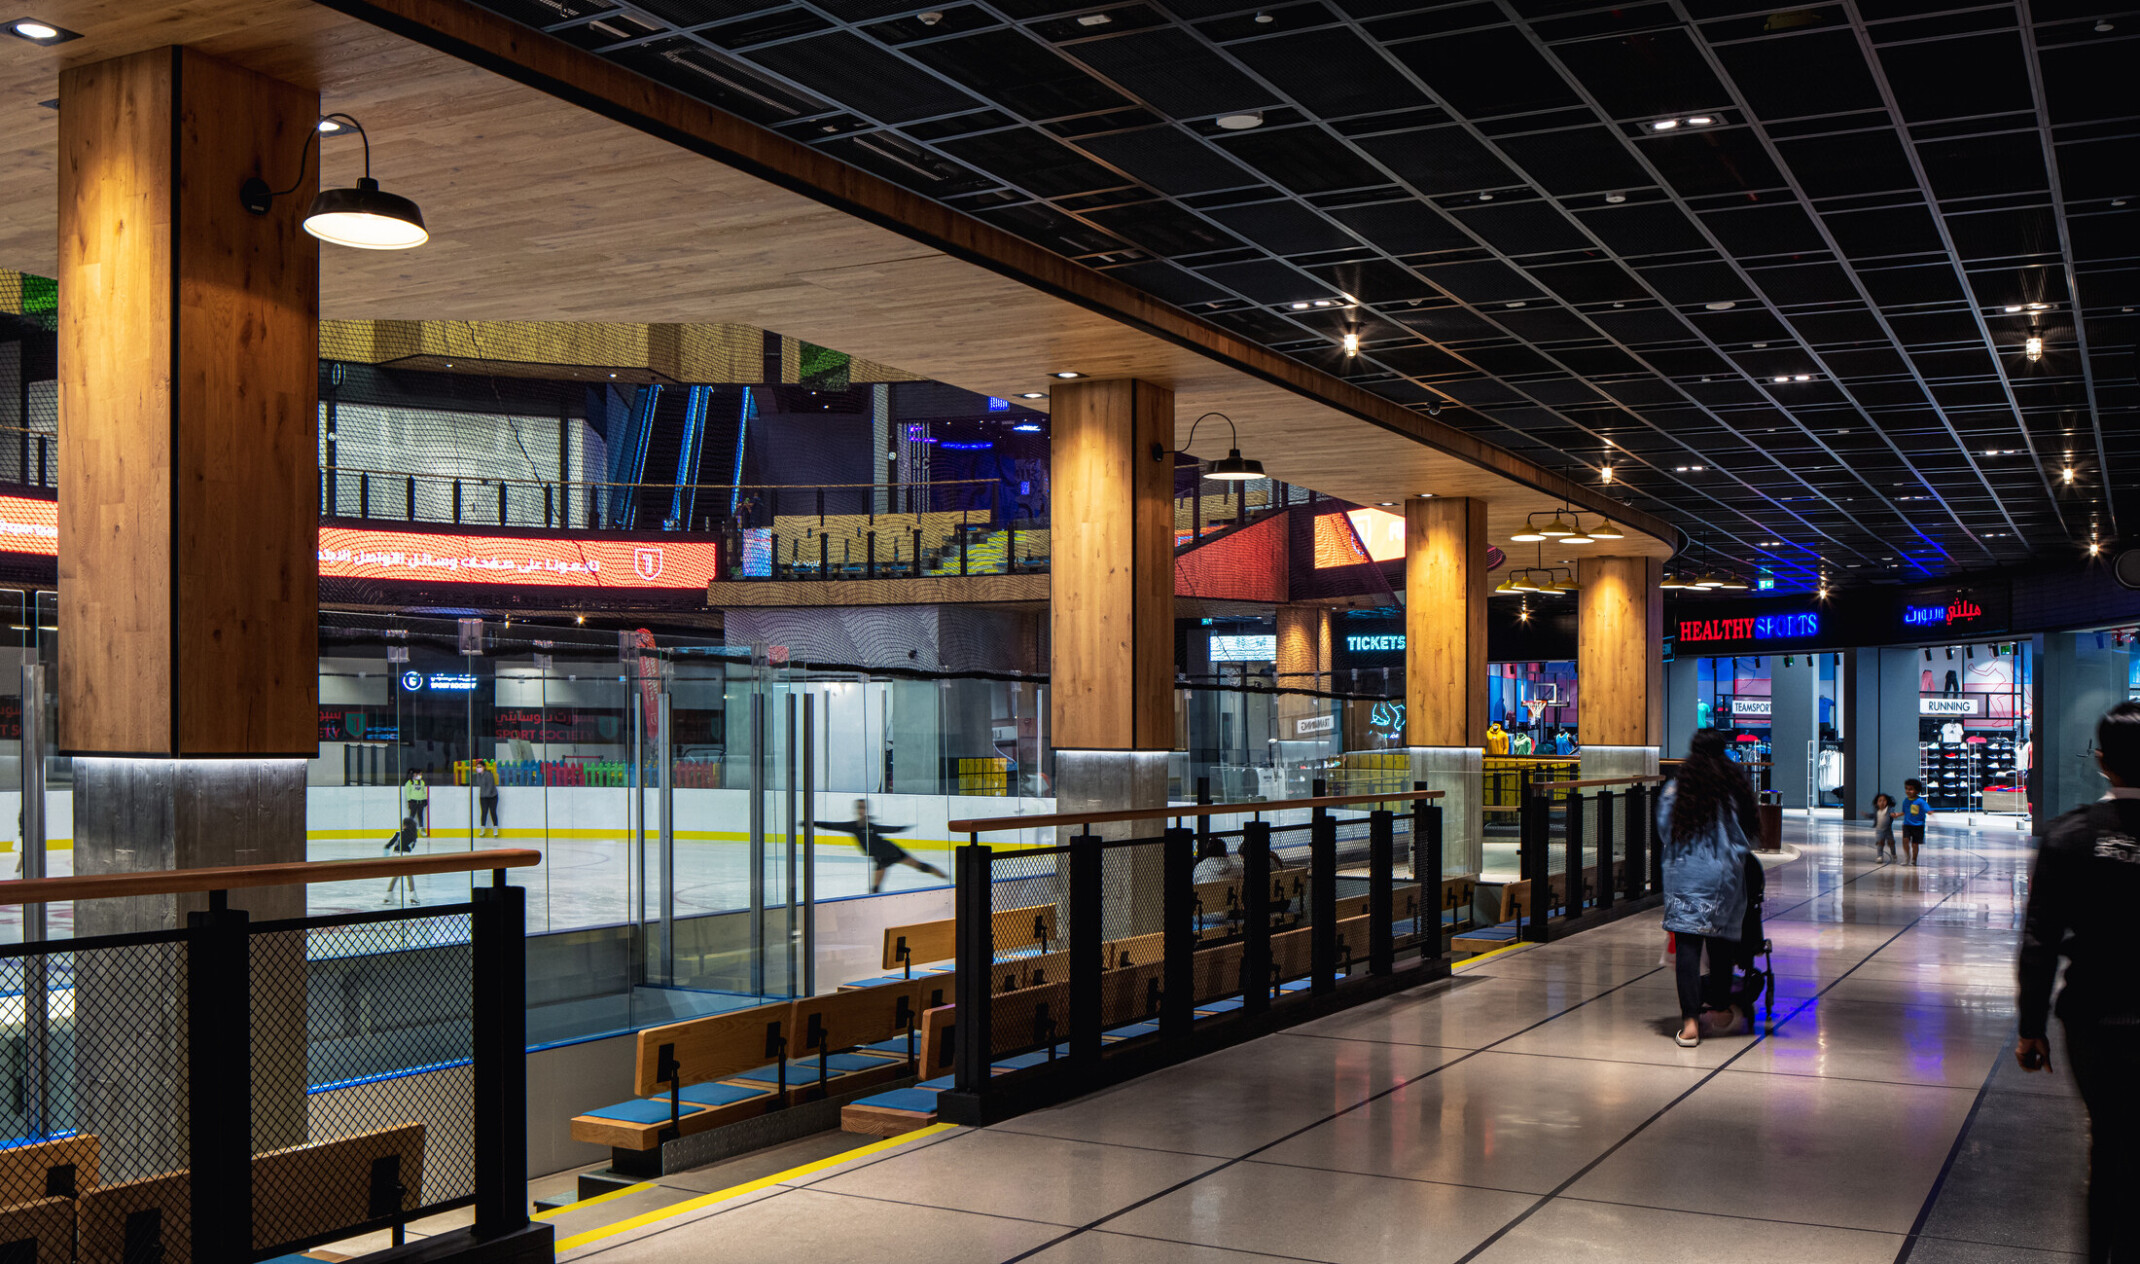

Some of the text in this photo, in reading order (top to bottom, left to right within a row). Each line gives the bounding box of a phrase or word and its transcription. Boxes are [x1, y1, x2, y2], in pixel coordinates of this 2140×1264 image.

[1946, 597, 1982, 625] هيلثي
[1680, 618, 1755, 642] HEALTHY
[1347, 635, 1406, 651] TICKETS
[1929, 701, 1970, 712] RUNNING
[496, 730, 536, 740] SPORT
